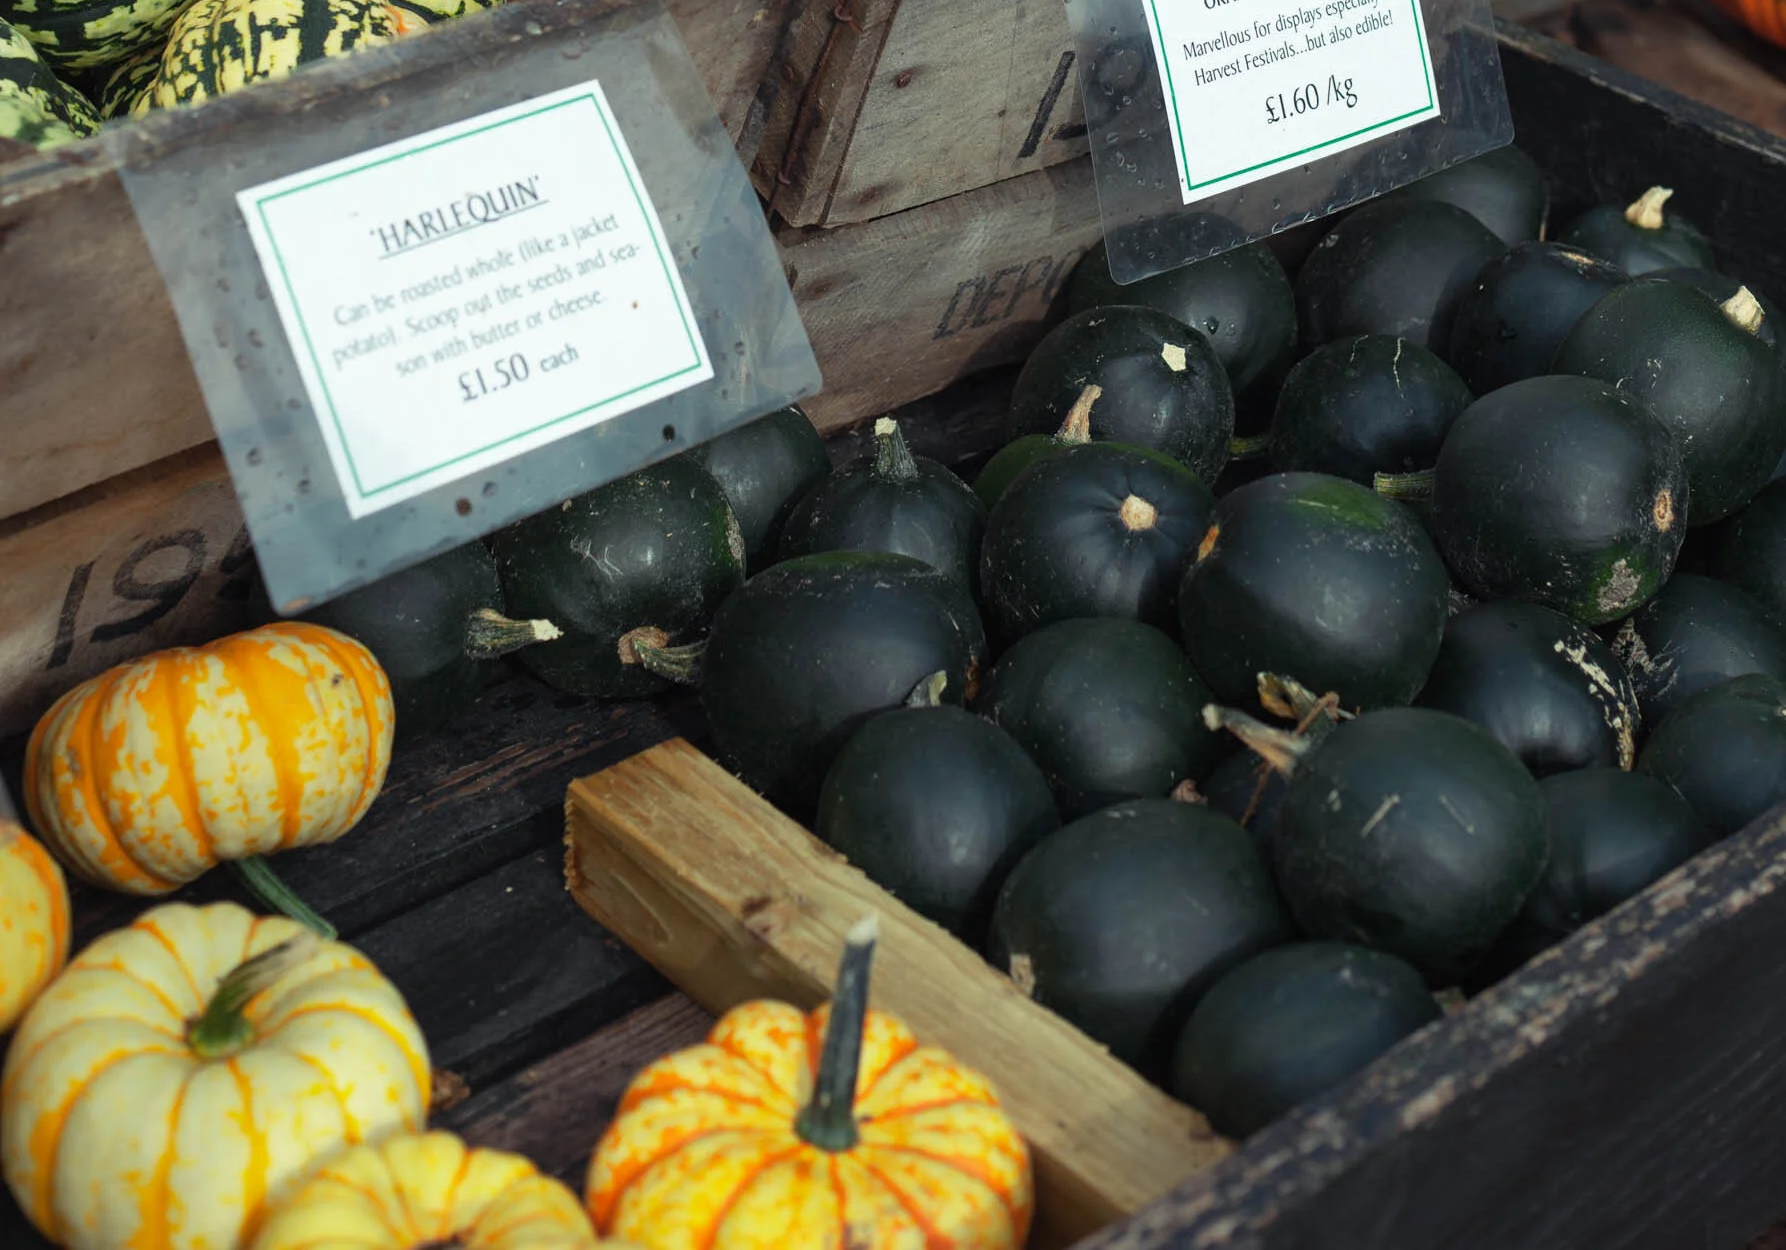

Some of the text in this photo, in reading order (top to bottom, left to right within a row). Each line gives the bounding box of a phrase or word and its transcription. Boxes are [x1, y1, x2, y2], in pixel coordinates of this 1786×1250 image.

[1183, 27, 1251, 60] Marvellous
[1253, 20, 1271, 40] for
[1275, 3, 1322, 34] displays
[1194, 59, 1242, 86] Harvest
[1329, 22, 1353, 44] also
[1355, 10, 1394, 36] edible!
[1265, 73, 1358, 124] £1.60 /kg
[334, 213, 620, 326] Can be roasted whole (like a jacket
[405, 307, 459, 337] Scoop
[464, 293, 492, 316] out
[496, 283, 523, 305] the
[527, 263, 573, 293] seeds
[576, 249, 606, 276] and
[609, 243, 640, 263] sea-
[396, 354, 428, 378] son
[431, 336, 468, 363] with
[470, 319, 520, 349] butter
[525, 311, 543, 330] or
[458, 343, 580, 403] £1.50 each
